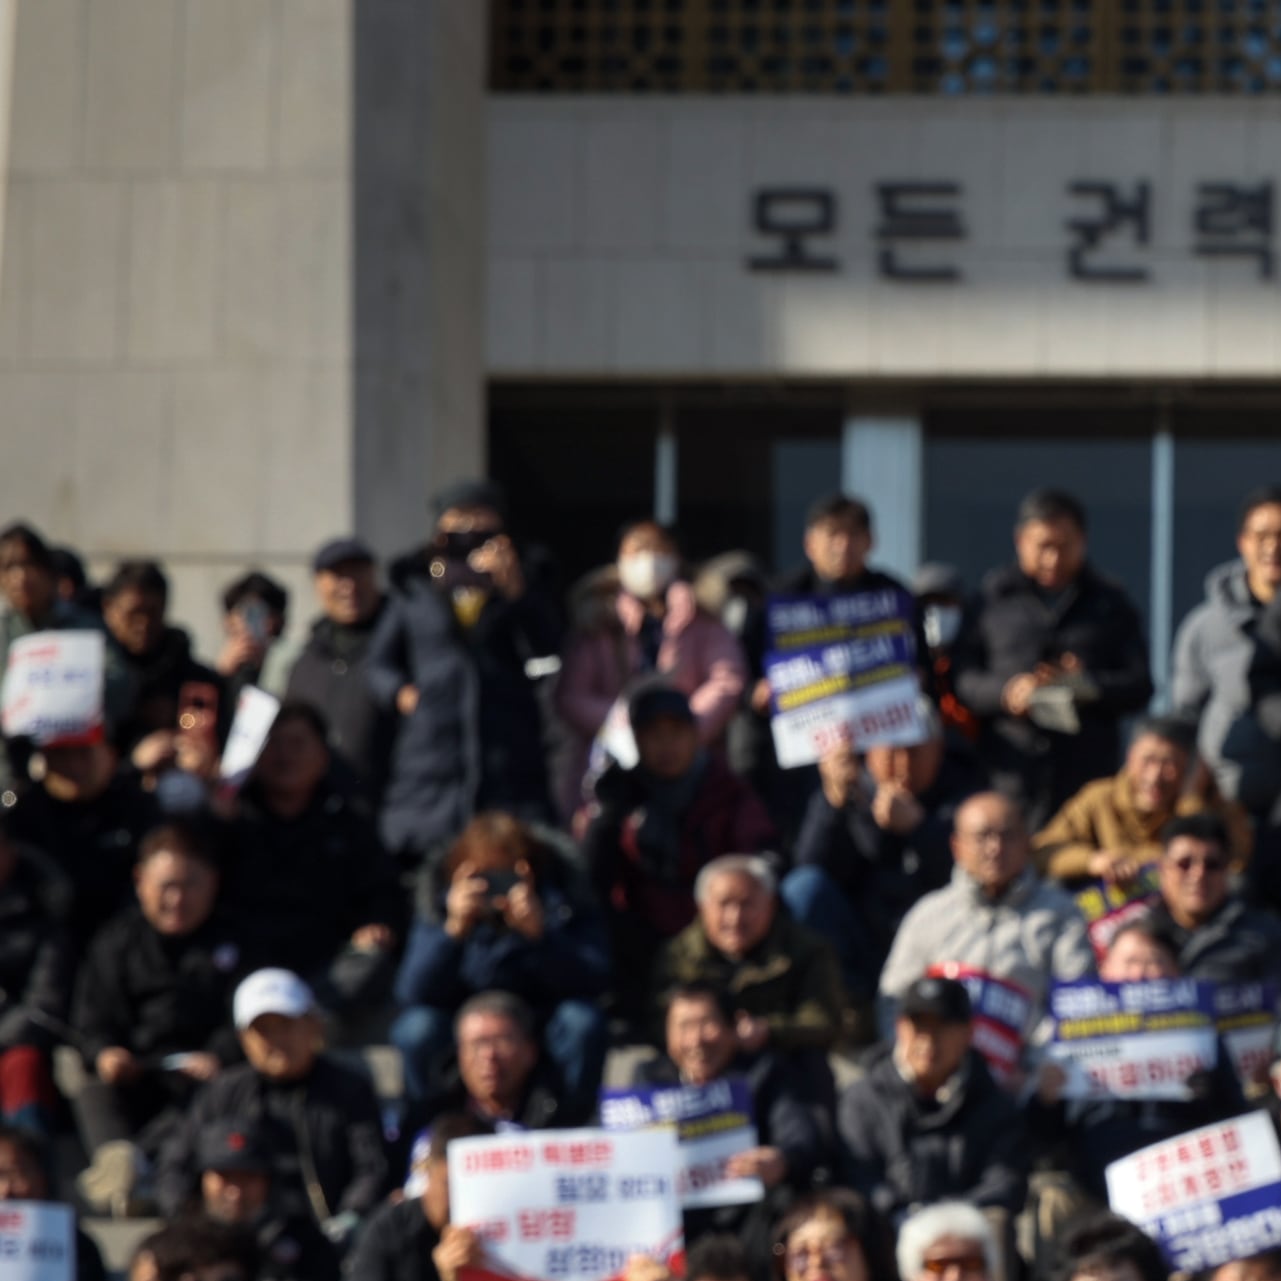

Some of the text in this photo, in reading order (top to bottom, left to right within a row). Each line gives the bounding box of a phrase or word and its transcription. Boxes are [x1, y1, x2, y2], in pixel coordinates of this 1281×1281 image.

[746, 179, 968, 283] 모든
[463, 1139, 615, 1173] 이름만 특별은
[556, 1173, 610, 1202] 필요
[517, 1208, 578, 1239] 당장
